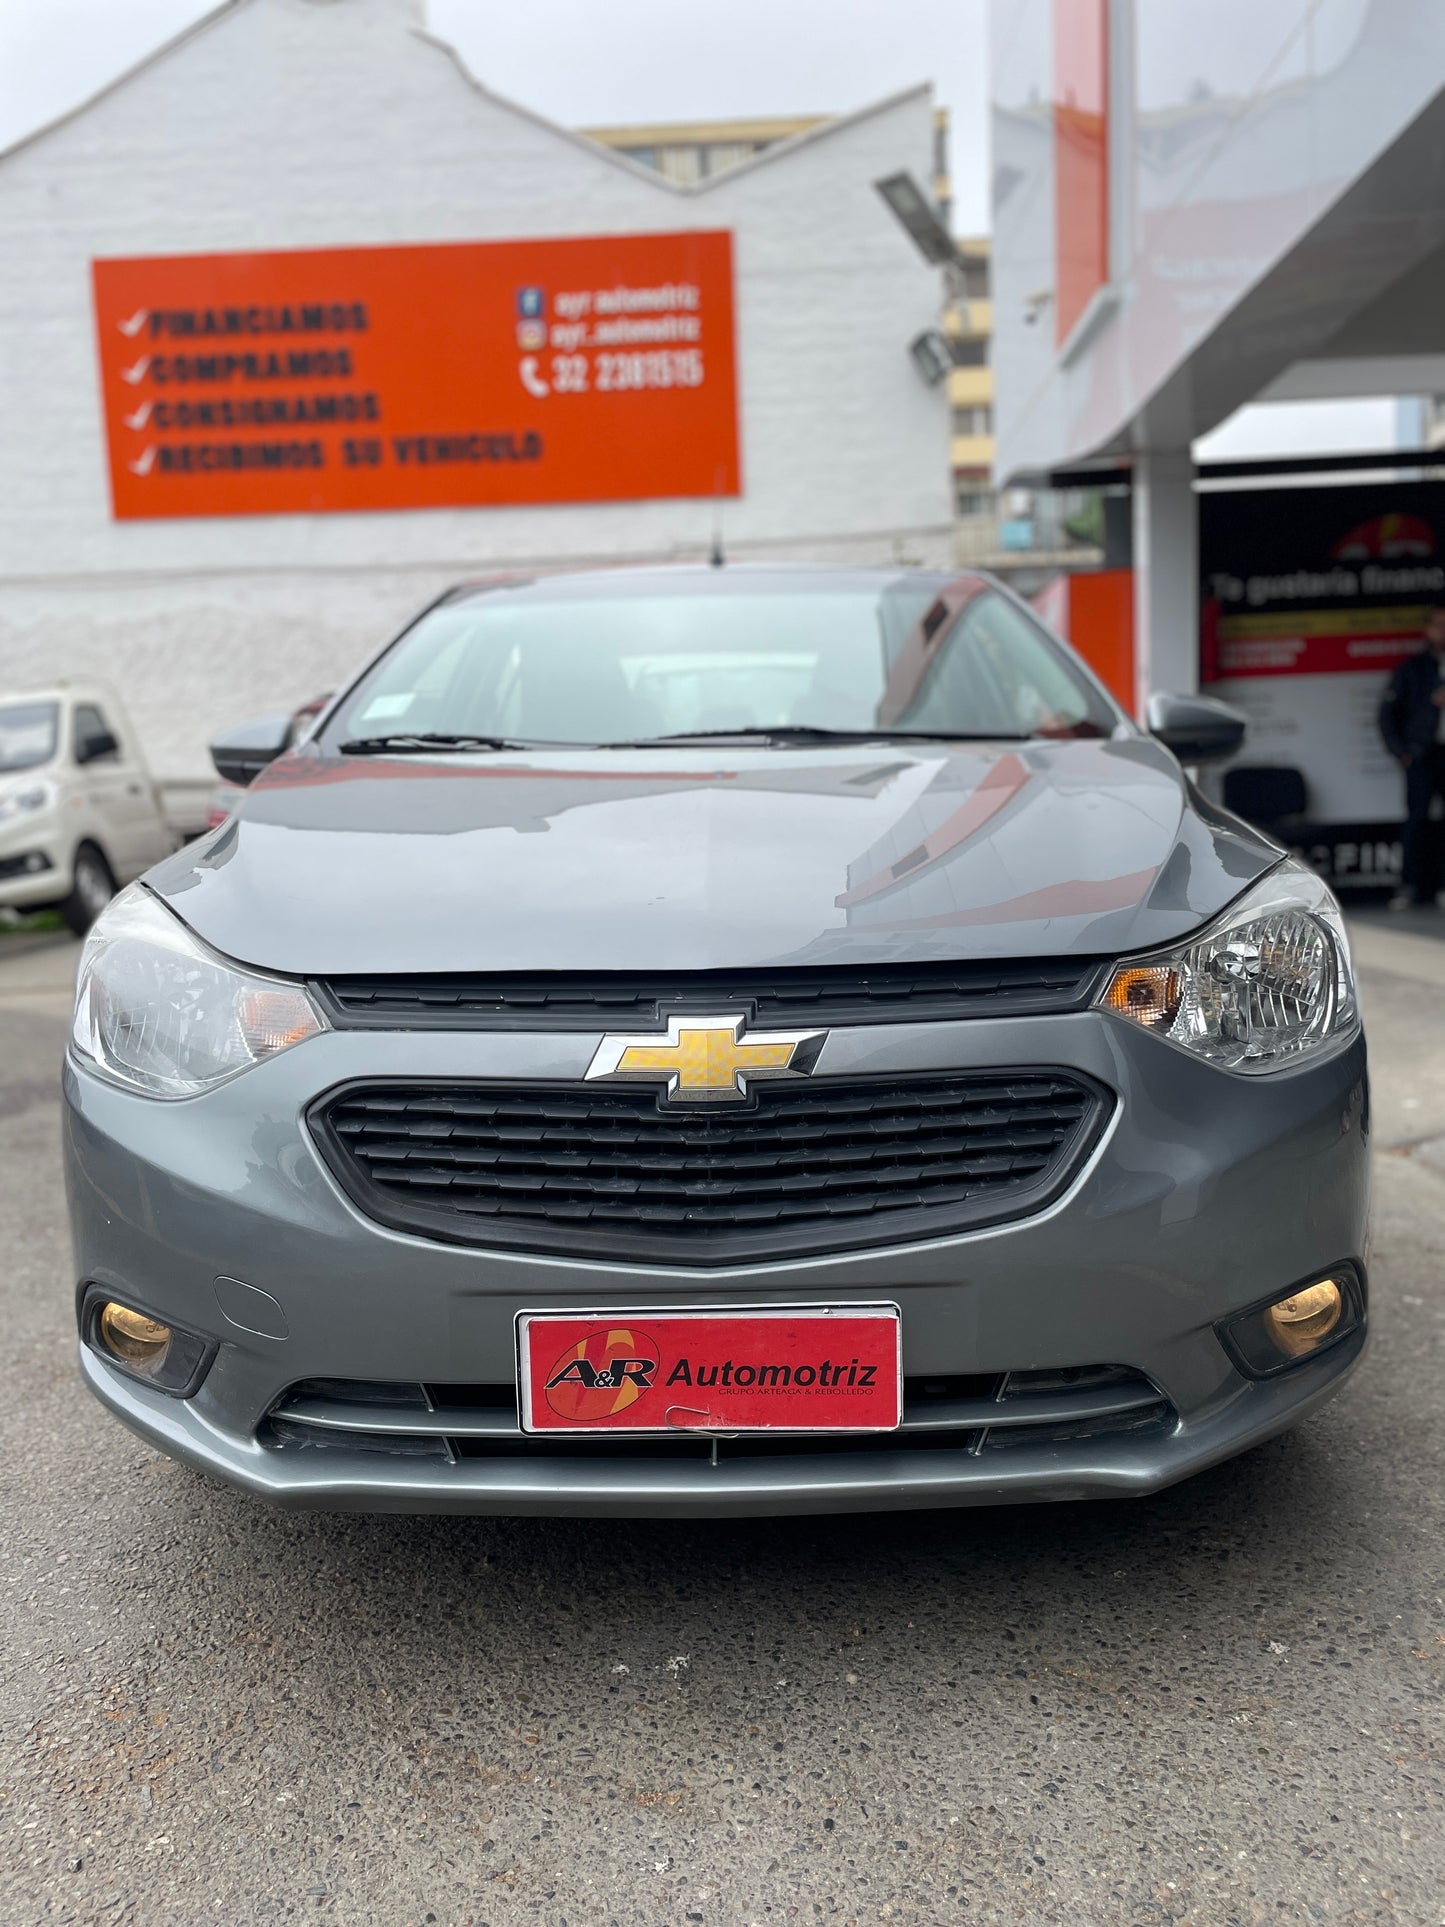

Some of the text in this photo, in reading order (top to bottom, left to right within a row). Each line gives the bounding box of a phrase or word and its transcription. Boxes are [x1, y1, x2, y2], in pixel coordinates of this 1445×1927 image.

[150, 303, 367, 339] FINANCIAMOS
[152, 348, 352, 384] COMPRAMOS
[154, 392, 378, 430] CONSIGNAMOS
[159, 429, 541, 476] RECIBIMOS SU VEHICULO
[544, 1358, 877, 1389] A&R Automotriz
